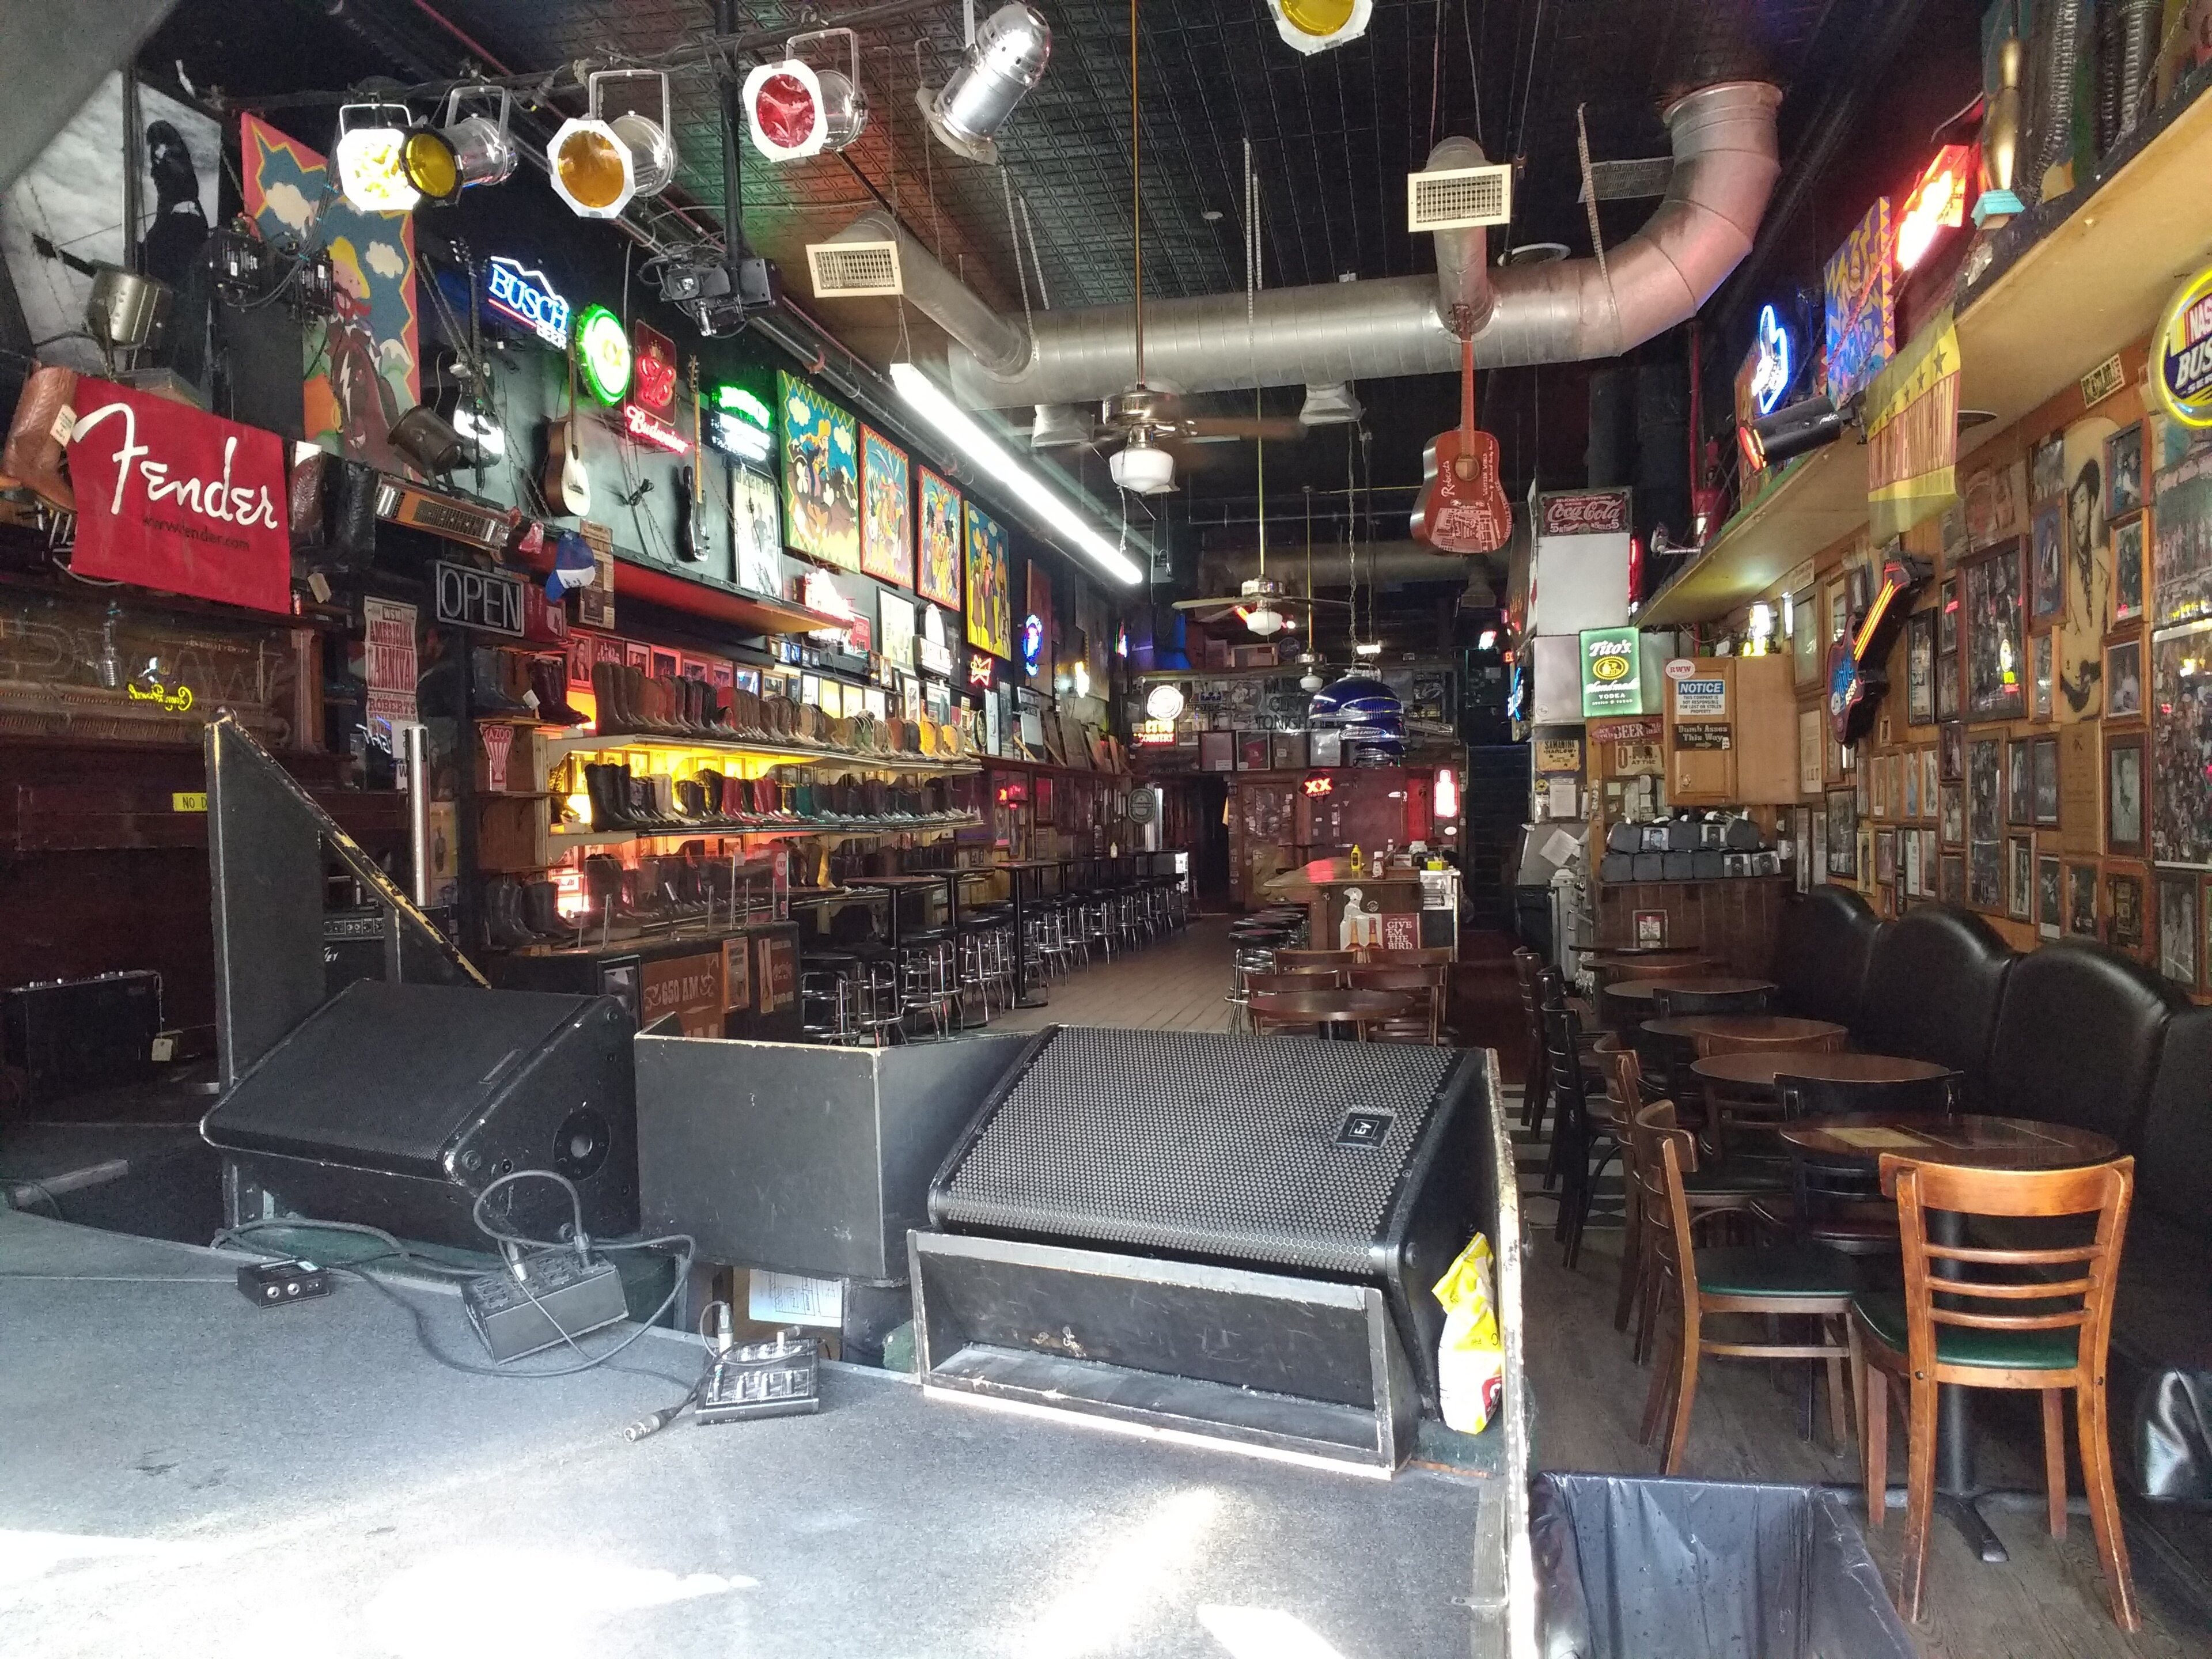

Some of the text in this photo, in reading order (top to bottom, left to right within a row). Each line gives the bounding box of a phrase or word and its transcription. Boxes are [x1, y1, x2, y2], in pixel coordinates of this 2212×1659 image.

[489, 264, 569, 334] BUSCH
[2190, 298, 2212, 343] NAS
[535, 320, 567, 350] BEER
[2175, 337, 2212, 390] BUS
[2187, 377, 2212, 396] SER
[72, 402, 278, 529] Fender
[1548, 499, 1622, 522] Coca-Cola
[1550, 523, 1559, 533] 5
[1611, 519, 1619, 529] 5
[441, 568, 521, 631] OPEN
[1680, 683, 1722, 693] NOTICE
[368, 698, 416, 715] ROBERTS
[1613, 724, 1644, 740] BEER
[1705, 733, 1723, 742] Way
[1544, 740, 1575, 749] SAMANTHA
[1304, 778, 1332, 794] XX
[183, 797, 195, 809] NO
[1387, 935, 1408, 943] THE
[662, 976, 699, 1006] 650 AM
